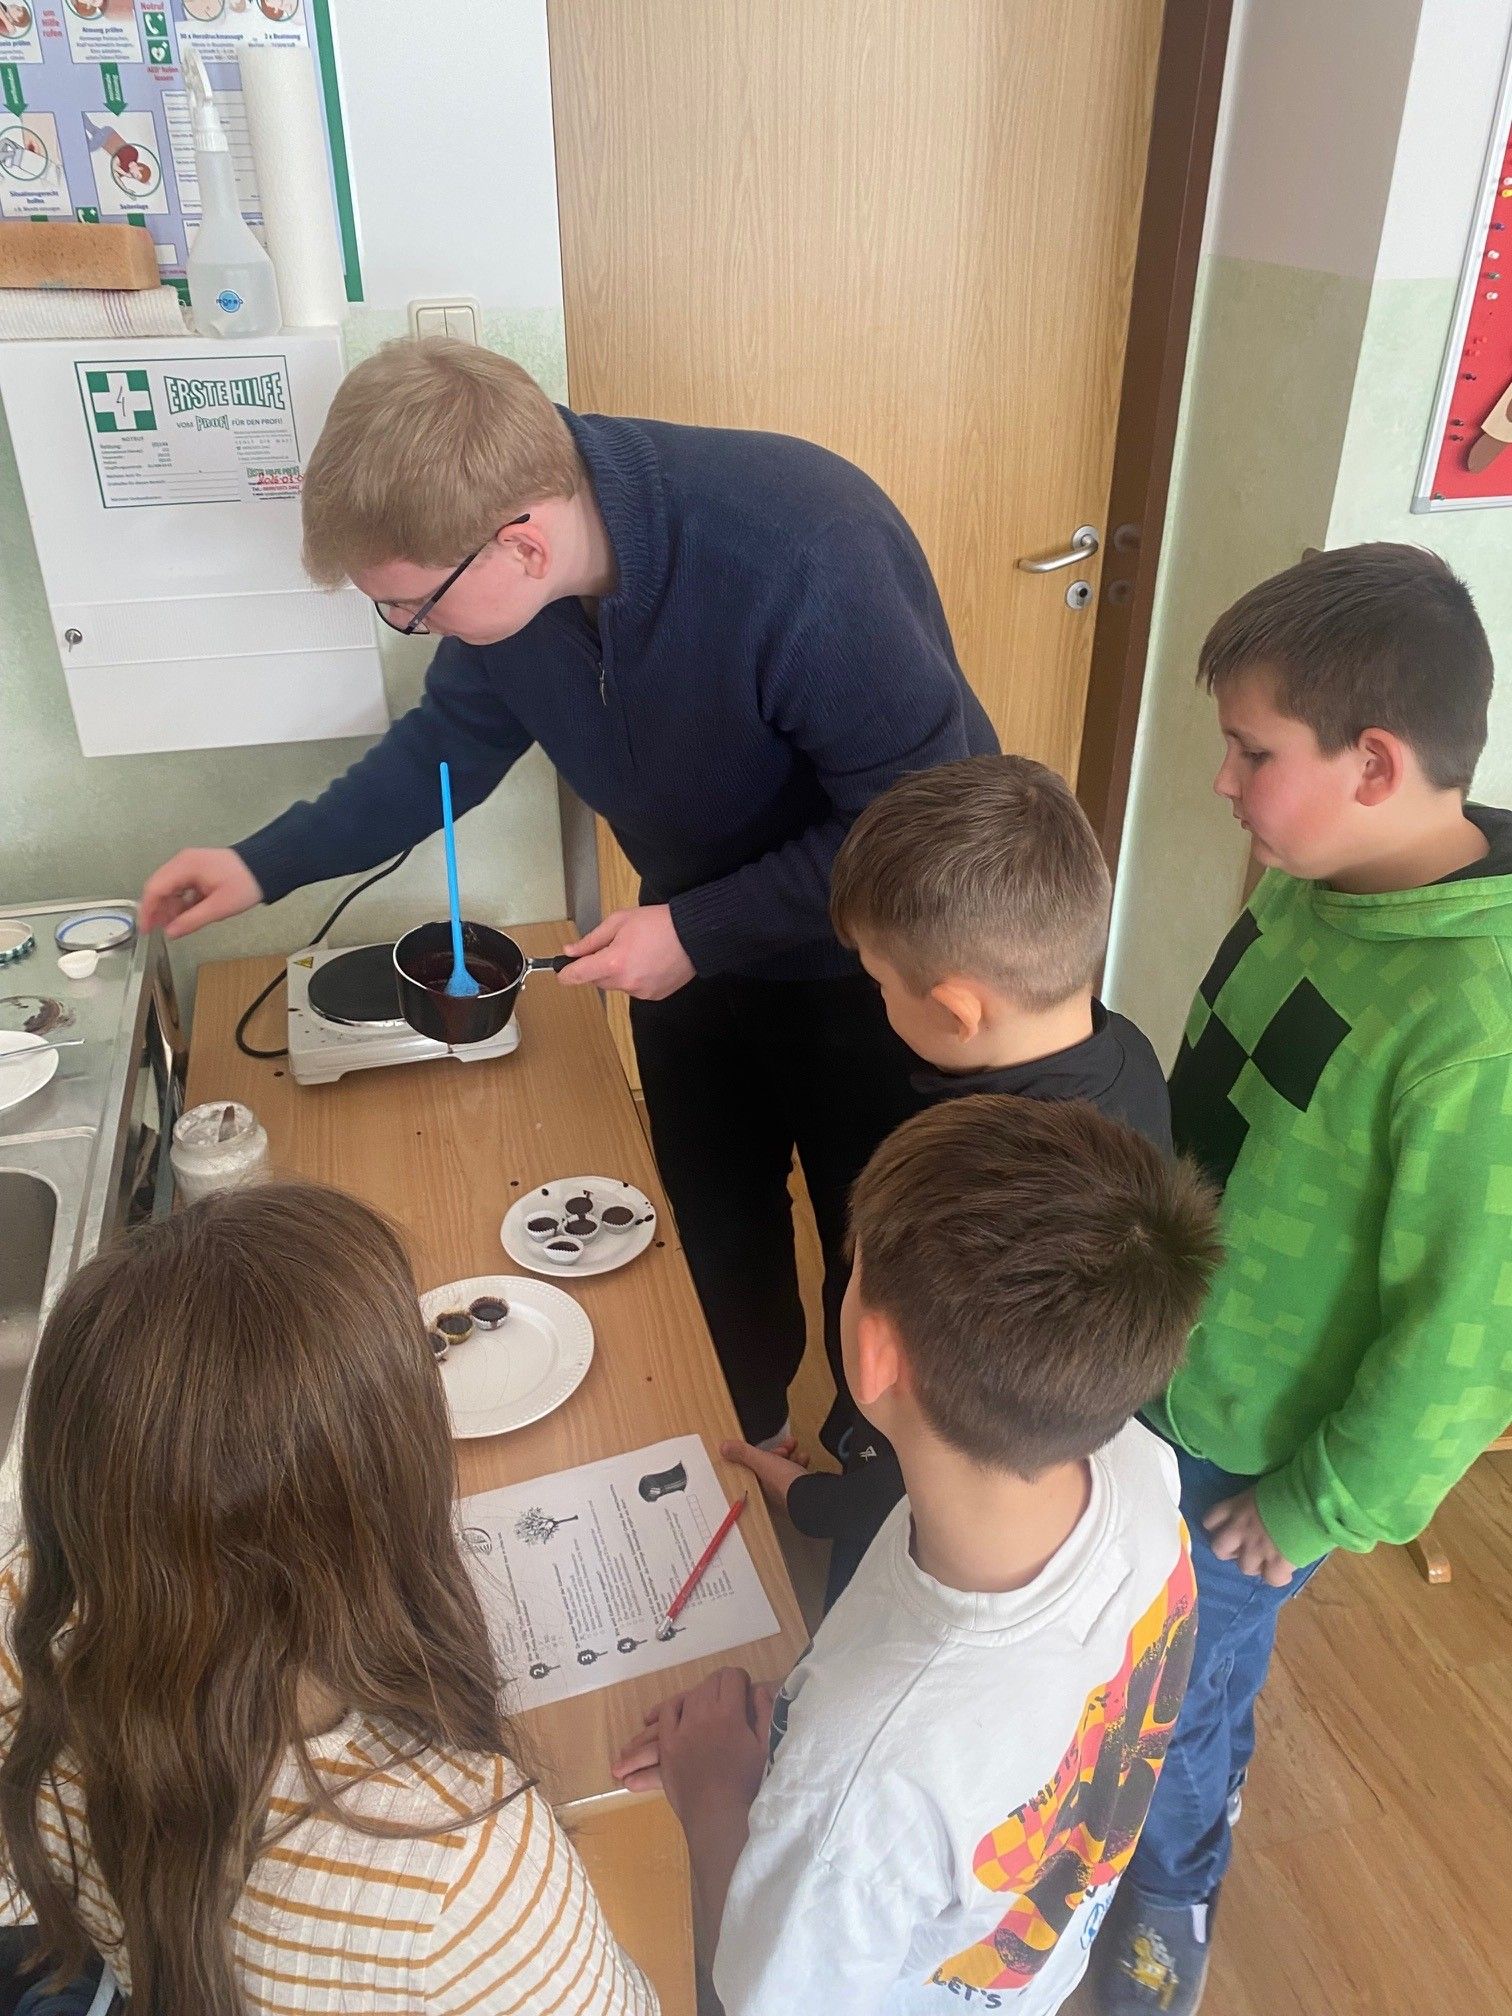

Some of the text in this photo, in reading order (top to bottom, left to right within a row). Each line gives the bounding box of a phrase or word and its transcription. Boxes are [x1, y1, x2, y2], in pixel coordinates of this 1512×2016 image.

[140, 2, 165, 11] Notruf
[42, 29, 63, 38] rufen
[163, 371, 286, 415] ERSTE HILFE
[176, 421, 194, 429] VOM
[231, 418, 246, 427] FÜR
[246, 418, 260, 426] DEN
[932, 1967, 1003, 2010] LET'S
